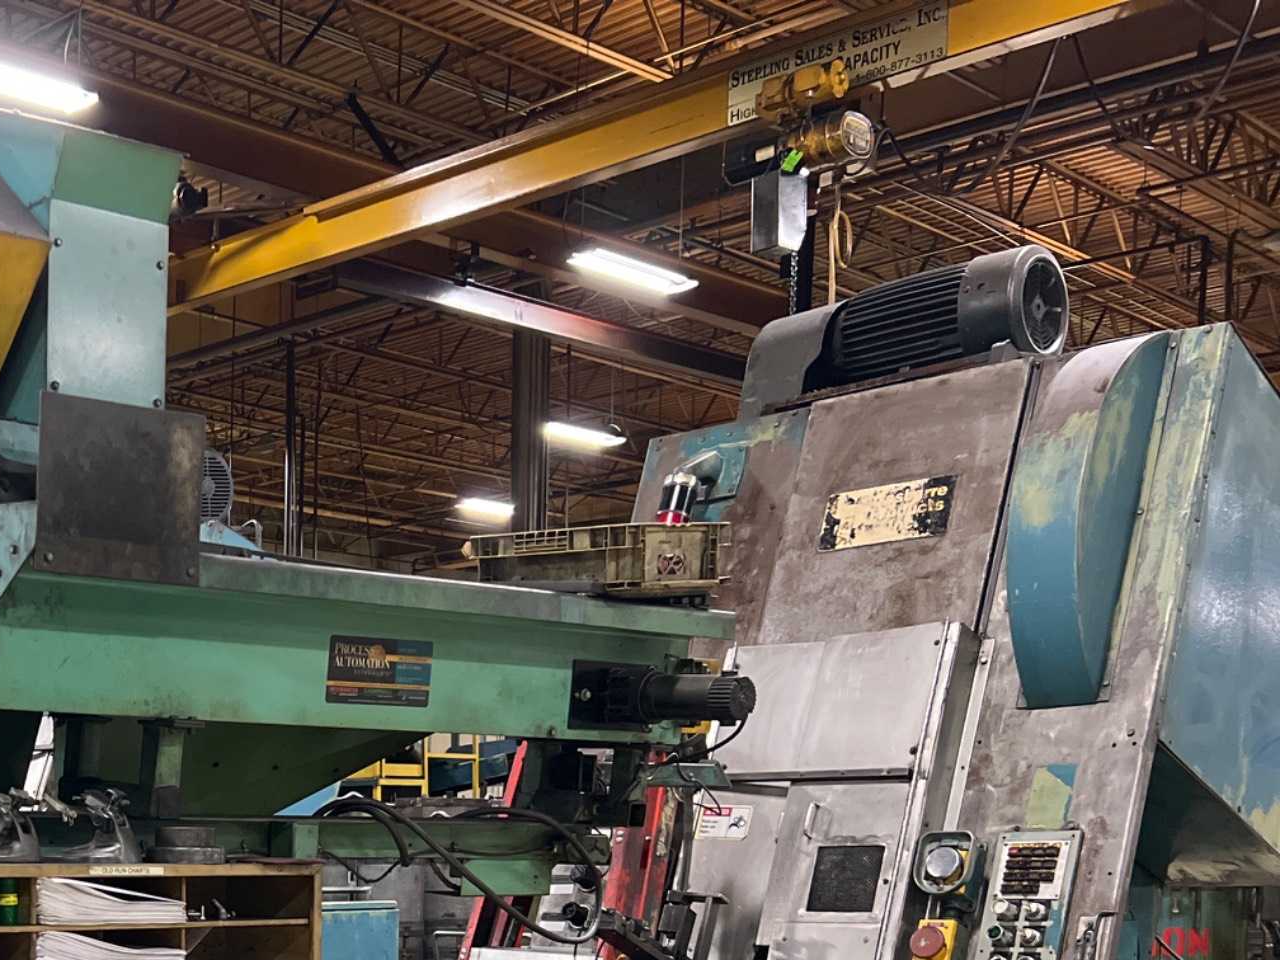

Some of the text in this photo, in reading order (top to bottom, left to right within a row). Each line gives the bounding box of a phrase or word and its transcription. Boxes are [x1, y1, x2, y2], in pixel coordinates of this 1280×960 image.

[795, 43, 833, 67] SALES
[838, 39, 847, 52] &
[917, 7, 945, 28] INC.
[335, 655, 390, 669] AUTOMATION
